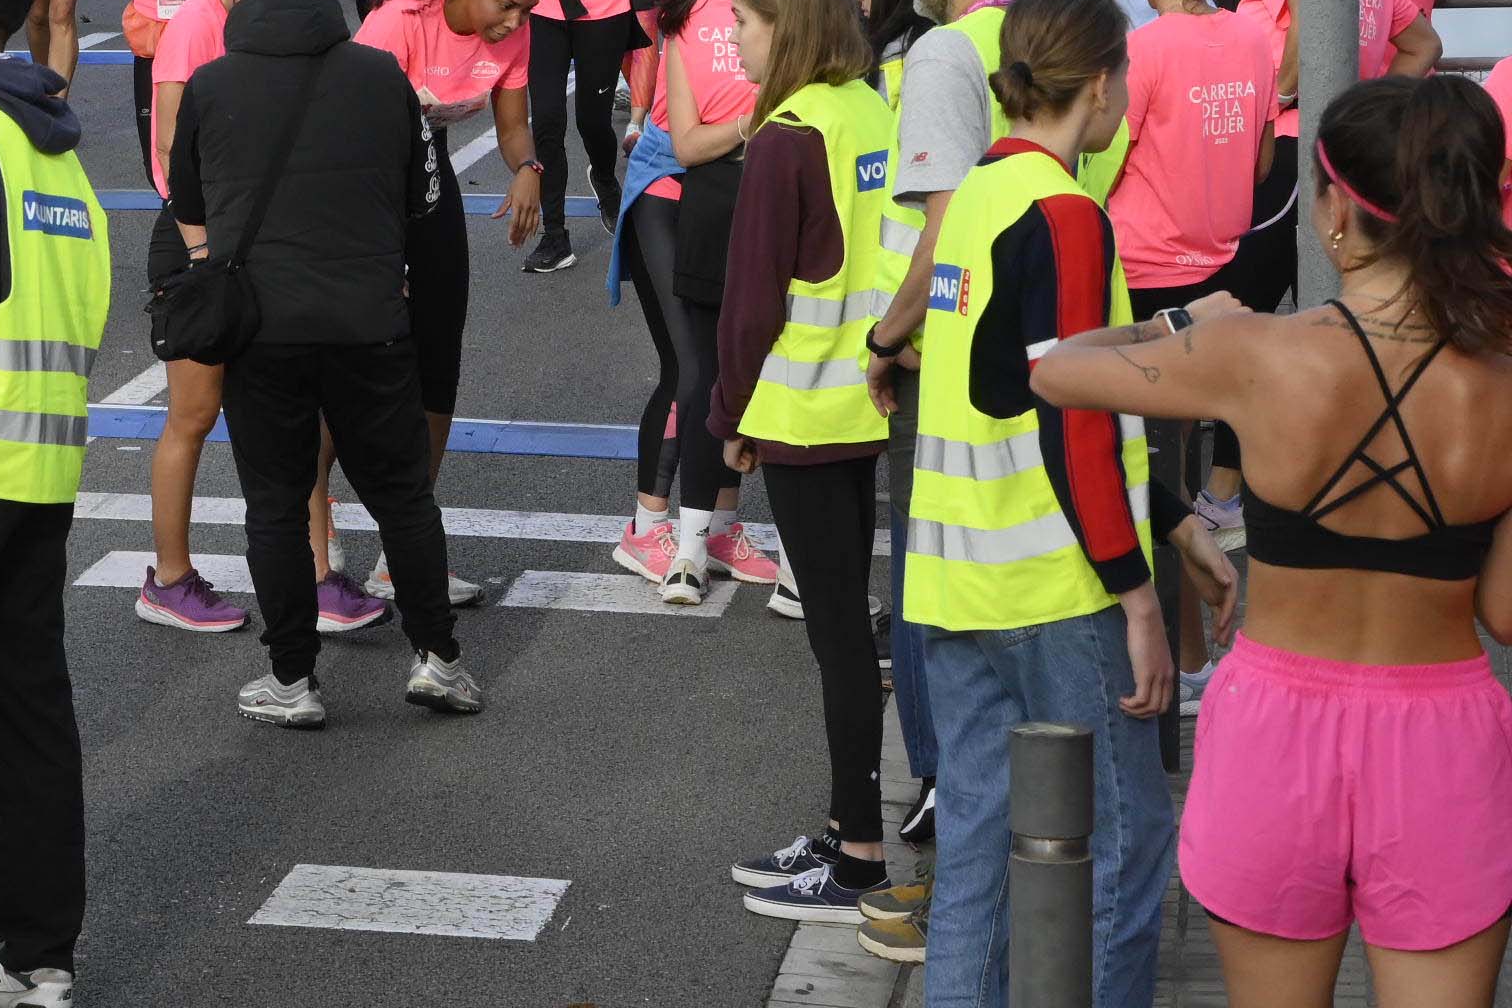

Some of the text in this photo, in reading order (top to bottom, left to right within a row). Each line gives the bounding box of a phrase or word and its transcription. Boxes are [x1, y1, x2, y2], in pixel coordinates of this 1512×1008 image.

[714, 43, 737, 58] DE
[1189, 81, 1256, 104] CARRERA
[1203, 100, 1241, 119] DE LA
